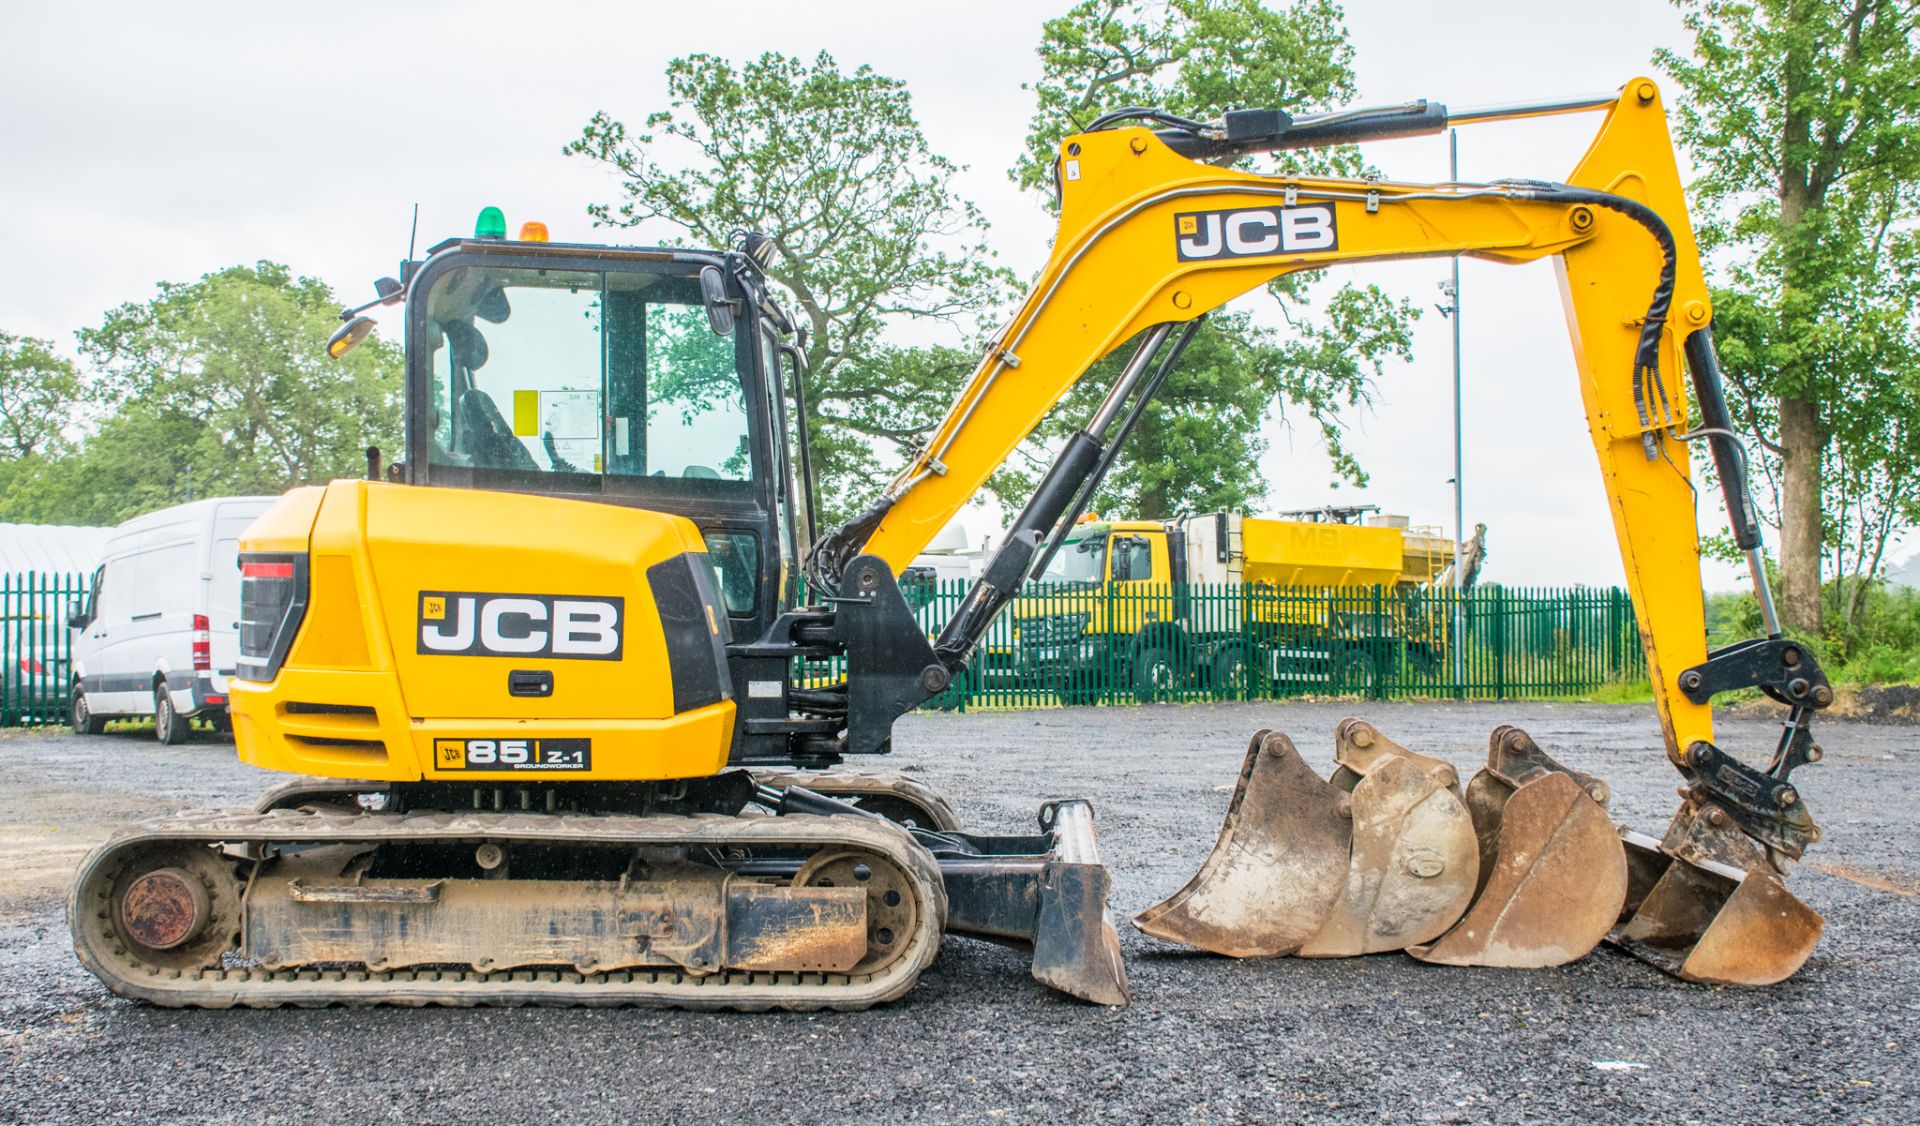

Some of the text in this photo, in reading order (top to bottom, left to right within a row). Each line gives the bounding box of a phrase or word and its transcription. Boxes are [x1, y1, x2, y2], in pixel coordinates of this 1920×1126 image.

[1180, 207, 1334, 258] JCB
[422, 597, 619, 655] JCB
[1266, 612, 1308, 621] SERVCE
[467, 740, 583, 763] 85 Z-1
